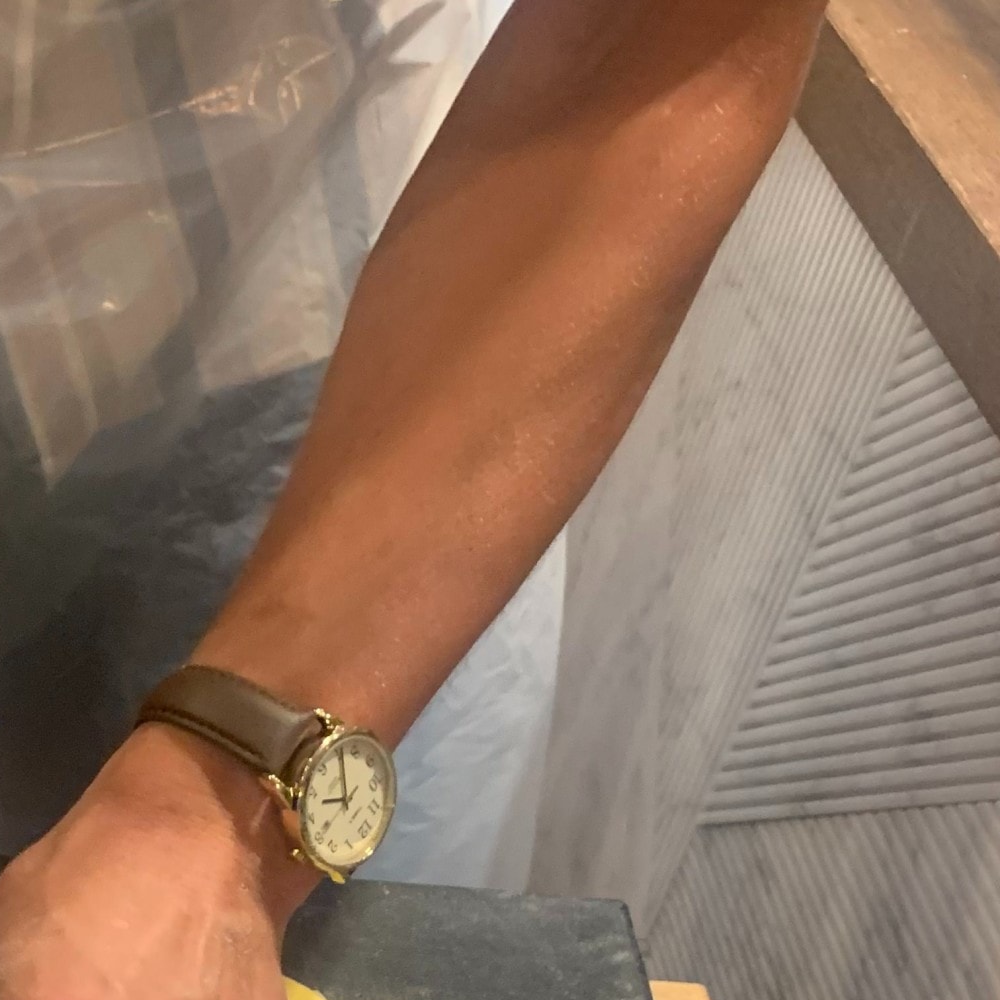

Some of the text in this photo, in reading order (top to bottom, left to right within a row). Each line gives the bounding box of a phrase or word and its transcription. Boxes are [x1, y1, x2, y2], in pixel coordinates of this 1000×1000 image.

[368, 774, 382, 791] 10
[368, 799, 381, 815] 11
[357, 819, 373, 839] 12
[327, 839, 338, 853] 2
[344, 839, 353, 850] 1
